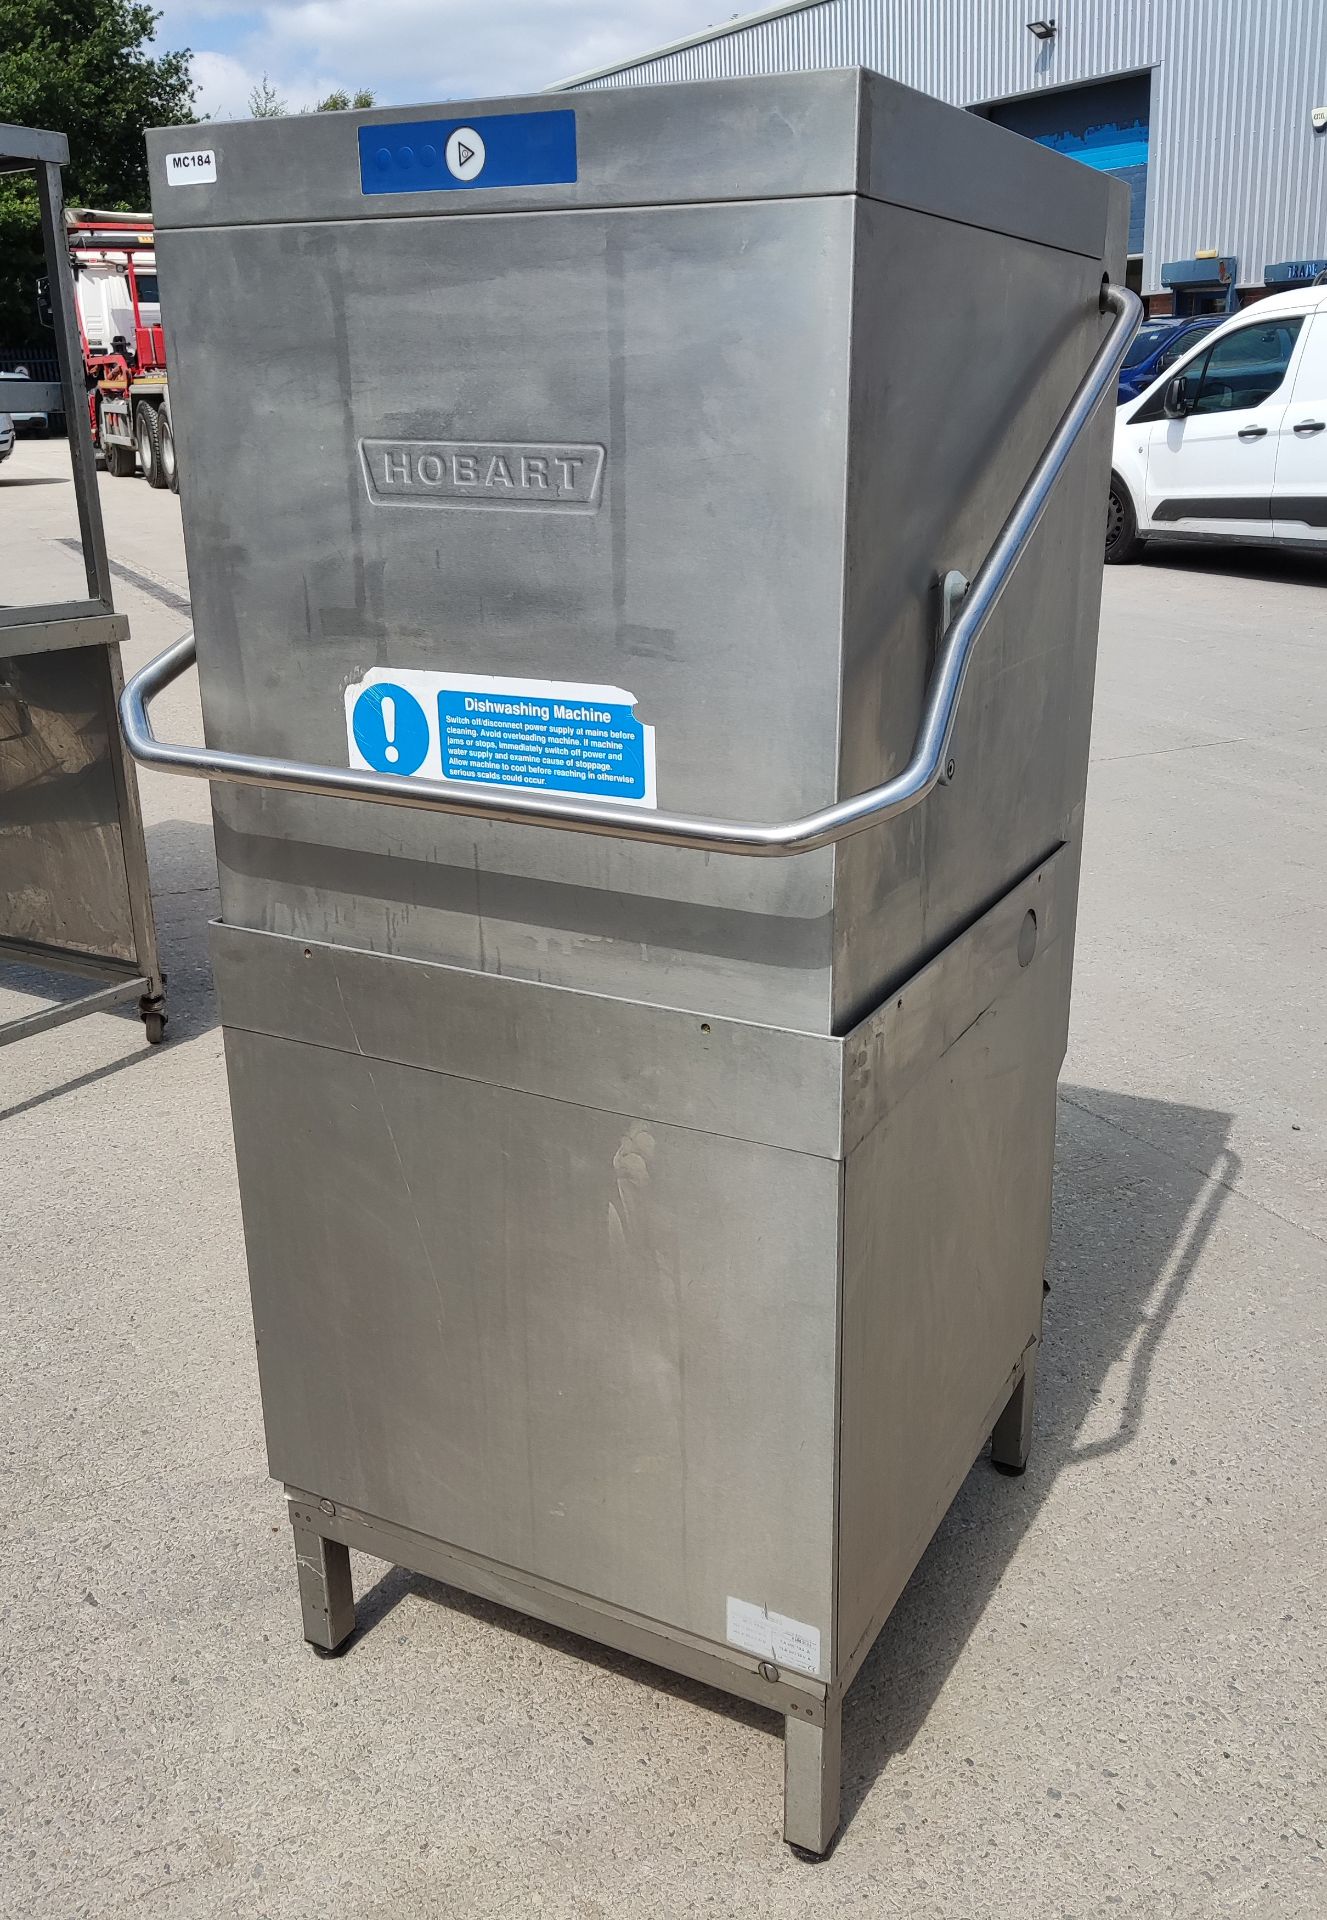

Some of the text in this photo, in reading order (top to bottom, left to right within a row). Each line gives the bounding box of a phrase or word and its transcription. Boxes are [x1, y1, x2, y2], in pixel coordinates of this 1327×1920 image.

[173, 154, 211, 168] MC184
[1288, 263, 1318, 278] TRADE
[384, 451, 584, 489] HOBART
[464, 697, 612, 723] Dishwashing Machine
[445, 715, 470, 724] Switch
[471, 718, 523, 729] off/disconnect
[524, 723, 547, 732] power
[549, 725, 574, 736] supply
[585, 729, 608, 738] mains
[610, 730, 635, 740] before
[446, 726, 623, 750] cleaning. Avoid overloading machine. If machine
[447, 736, 464, 745] jams
[475, 740, 497, 749] stops,
[499, 741, 542, 754] immediately
[544, 746, 568, 755] switch
[582, 750, 606, 759] power
[608, 752, 622, 760] and
[448, 748, 612, 771] water supply and examine cause of stoppage.
[448, 757, 635, 784] Allow machine to cool before reaching in otherwise
[449, 768, 548, 785] serious scalds could occur.
